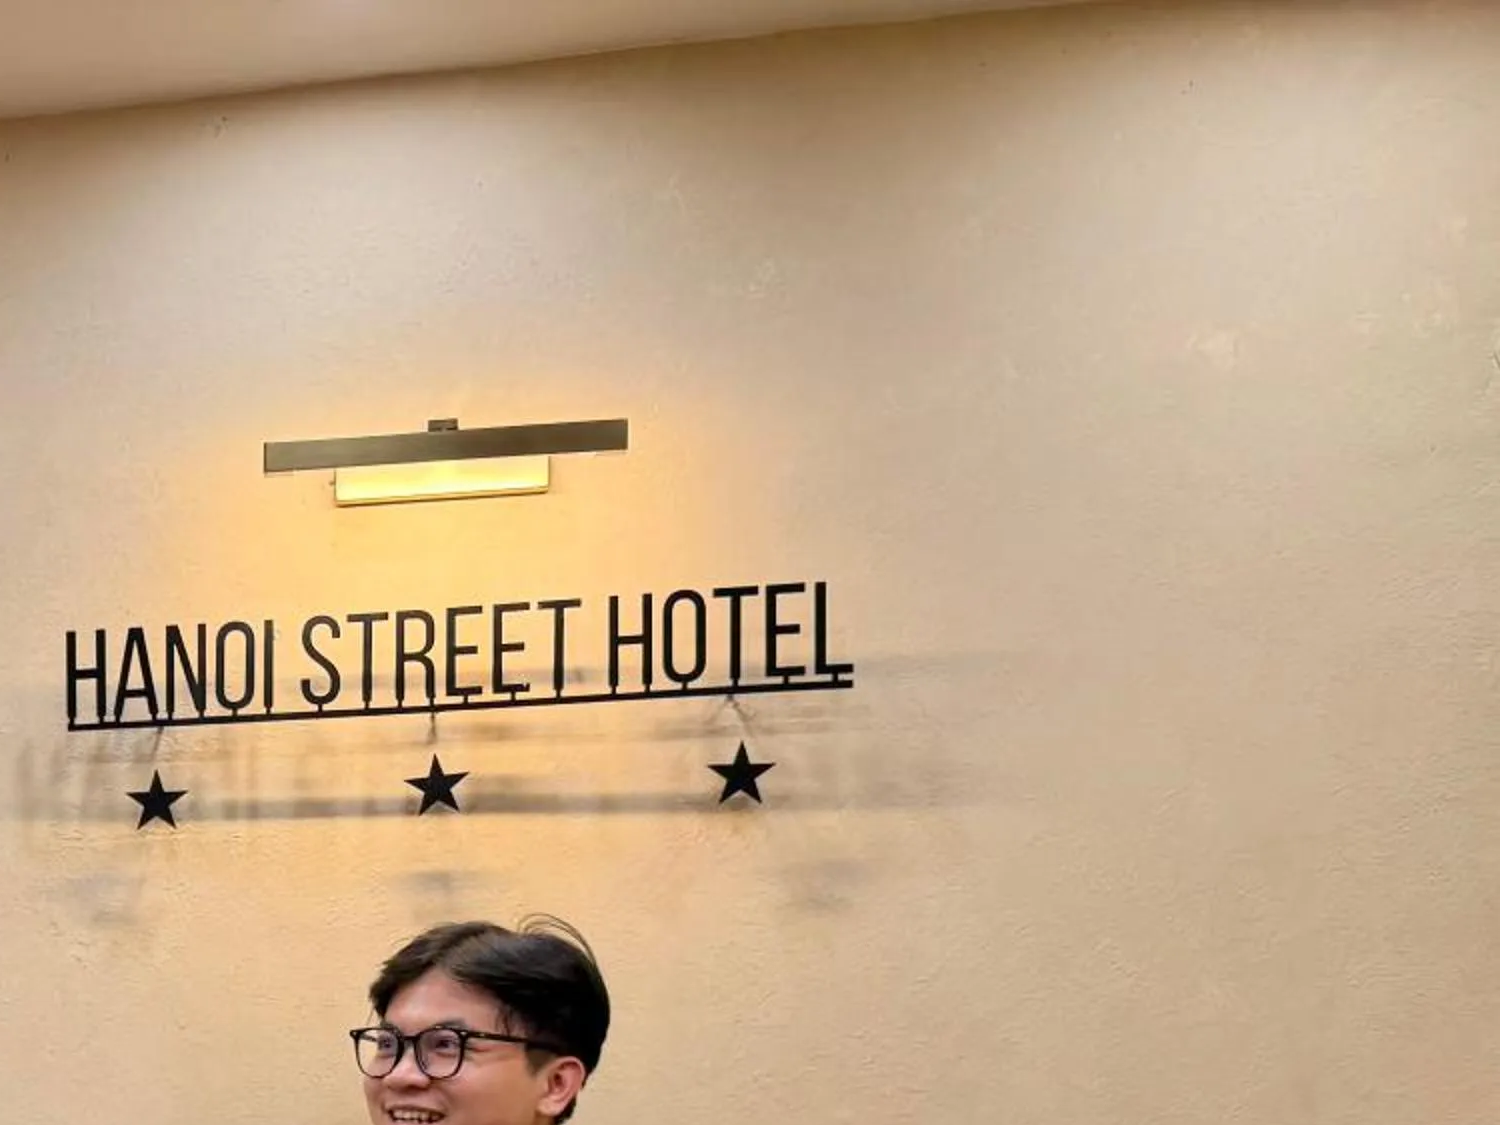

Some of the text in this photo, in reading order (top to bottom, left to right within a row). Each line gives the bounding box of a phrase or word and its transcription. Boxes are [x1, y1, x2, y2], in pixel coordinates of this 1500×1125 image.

[65, 581, 854, 721] HANOI STREET HOTEL
